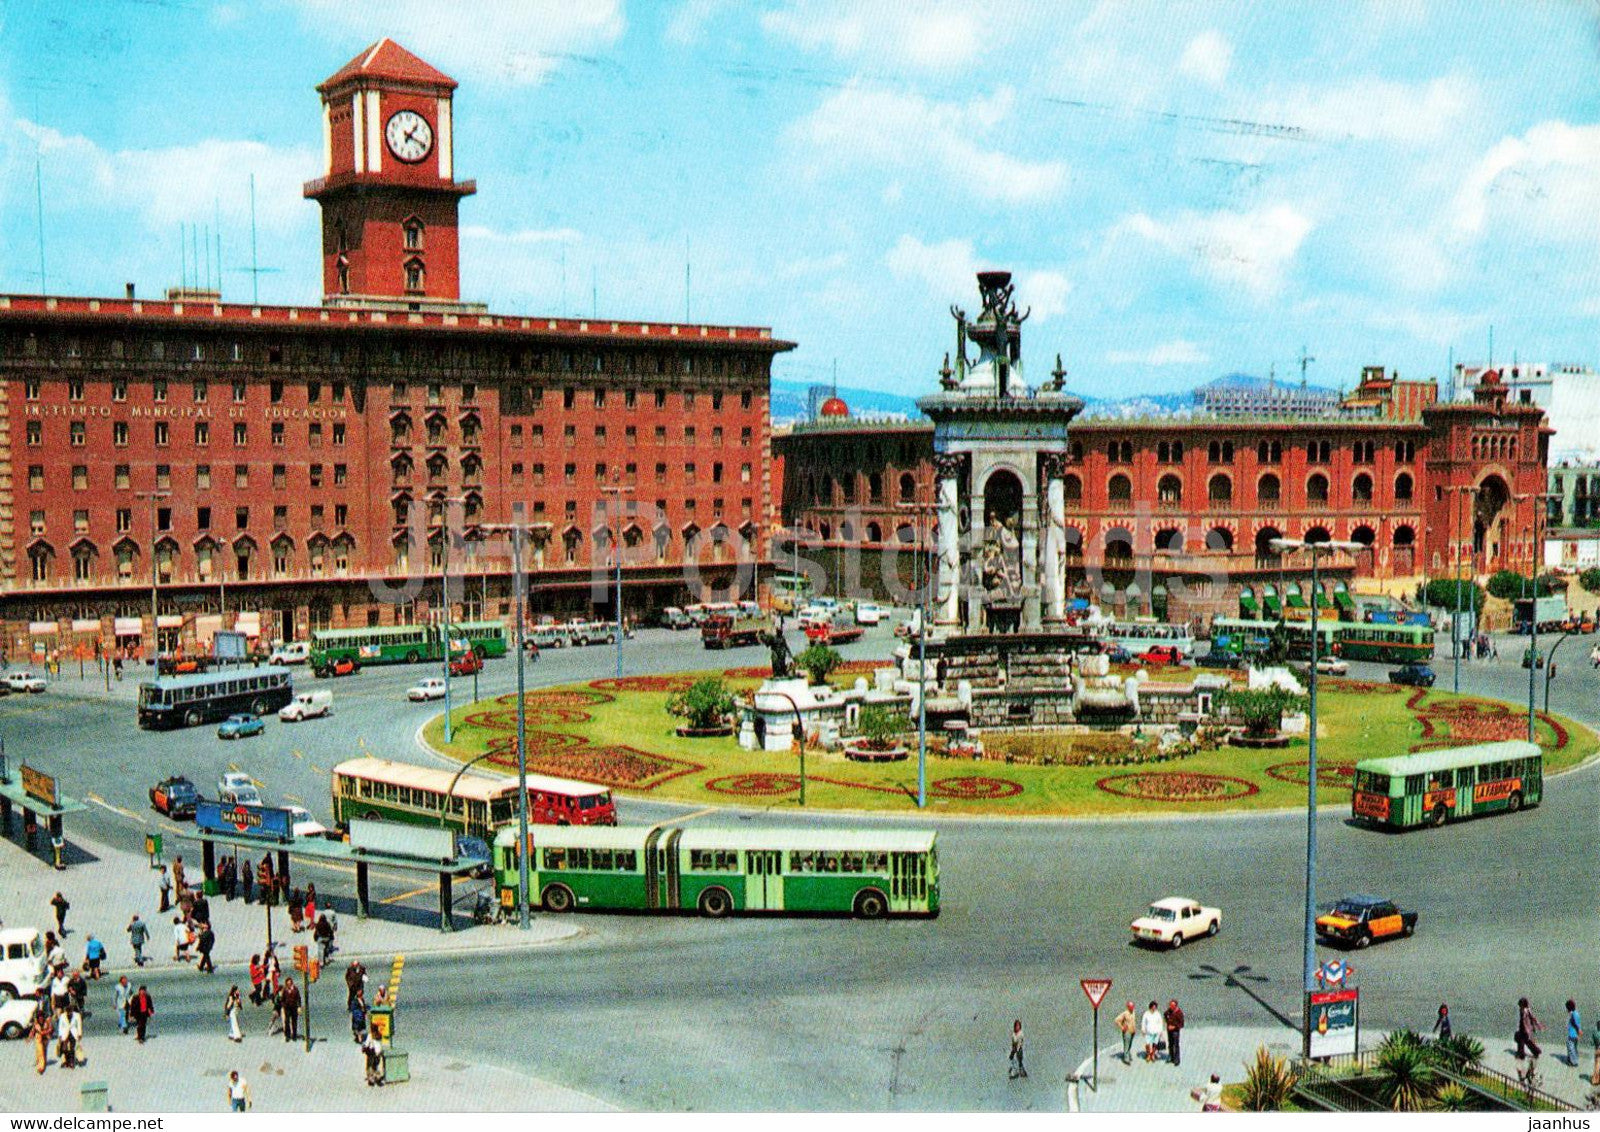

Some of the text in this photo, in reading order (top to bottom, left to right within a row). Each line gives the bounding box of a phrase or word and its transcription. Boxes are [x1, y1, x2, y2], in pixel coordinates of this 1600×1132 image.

[24, 404, 111, 417] INSTITUTO
[131, 405, 214, 418] MUNICIPAL
[228, 406, 245, 418] DE
[223, 811, 262, 827] MARTINI
